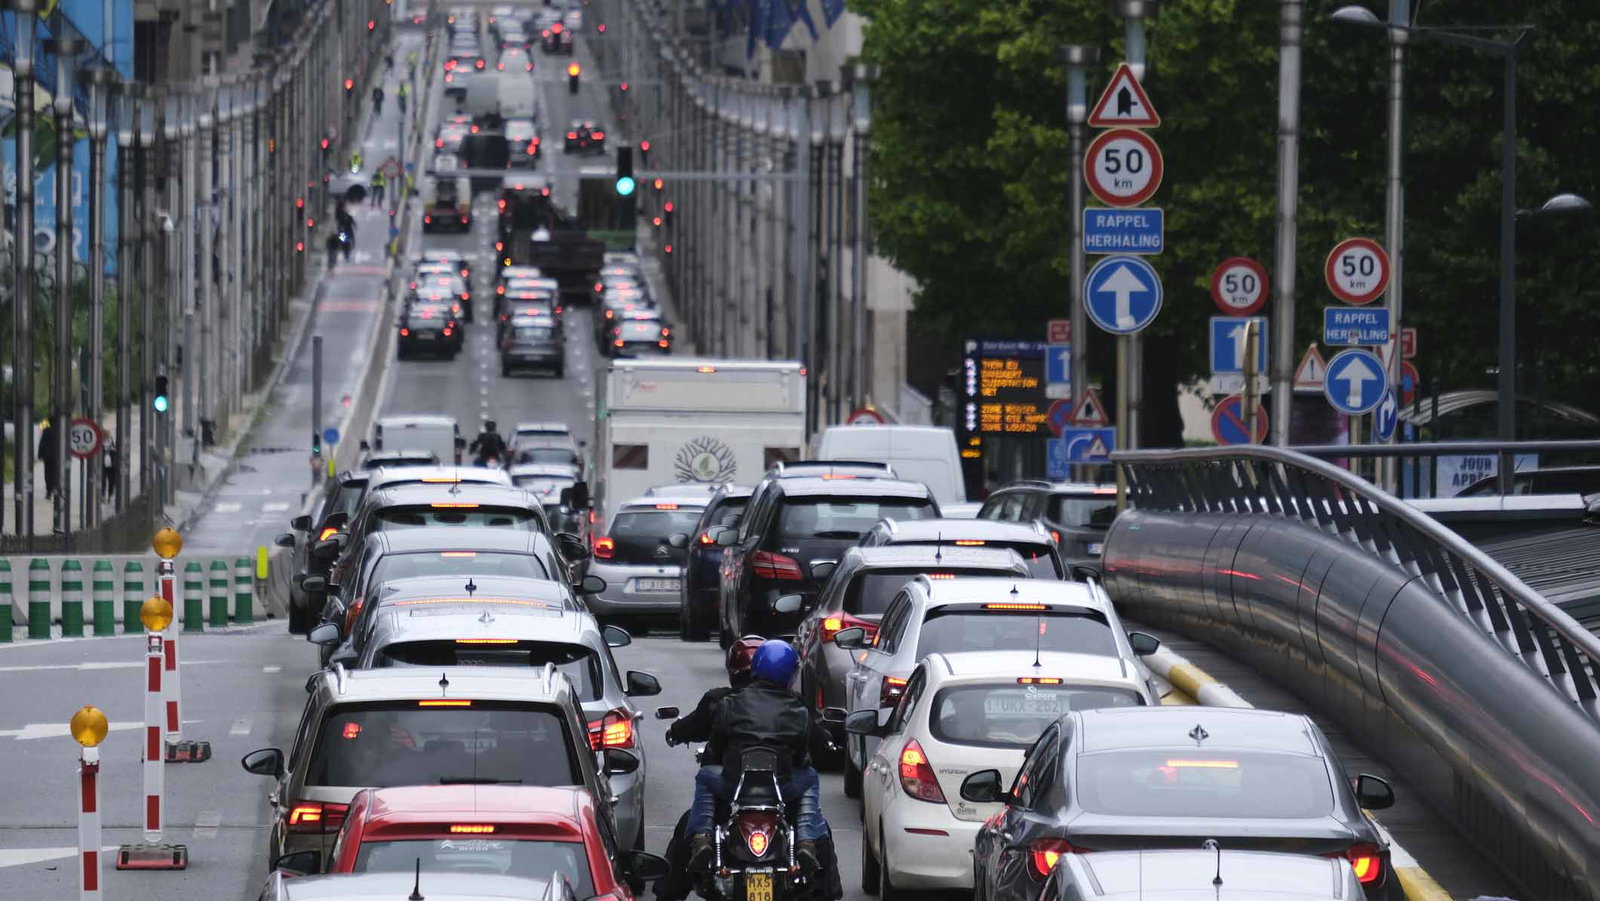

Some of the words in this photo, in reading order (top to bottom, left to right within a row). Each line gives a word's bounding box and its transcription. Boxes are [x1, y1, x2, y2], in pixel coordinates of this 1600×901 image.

[1104, 148, 1143, 174] 50
[1114, 178, 1133, 189] km
[1096, 215, 1150, 228] RAPPEL
[1086, 234, 1161, 247] HERHALING
[1343, 255, 1374, 277] 50
[1225, 274, 1255, 294] 50
[1350, 279, 1366, 289] km
[1232, 295, 1248, 304] km
[1335, 313, 1379, 324] RAPPEL
[72, 429, 93, 444] 50
[1460, 457, 1492, 471] JOUR
